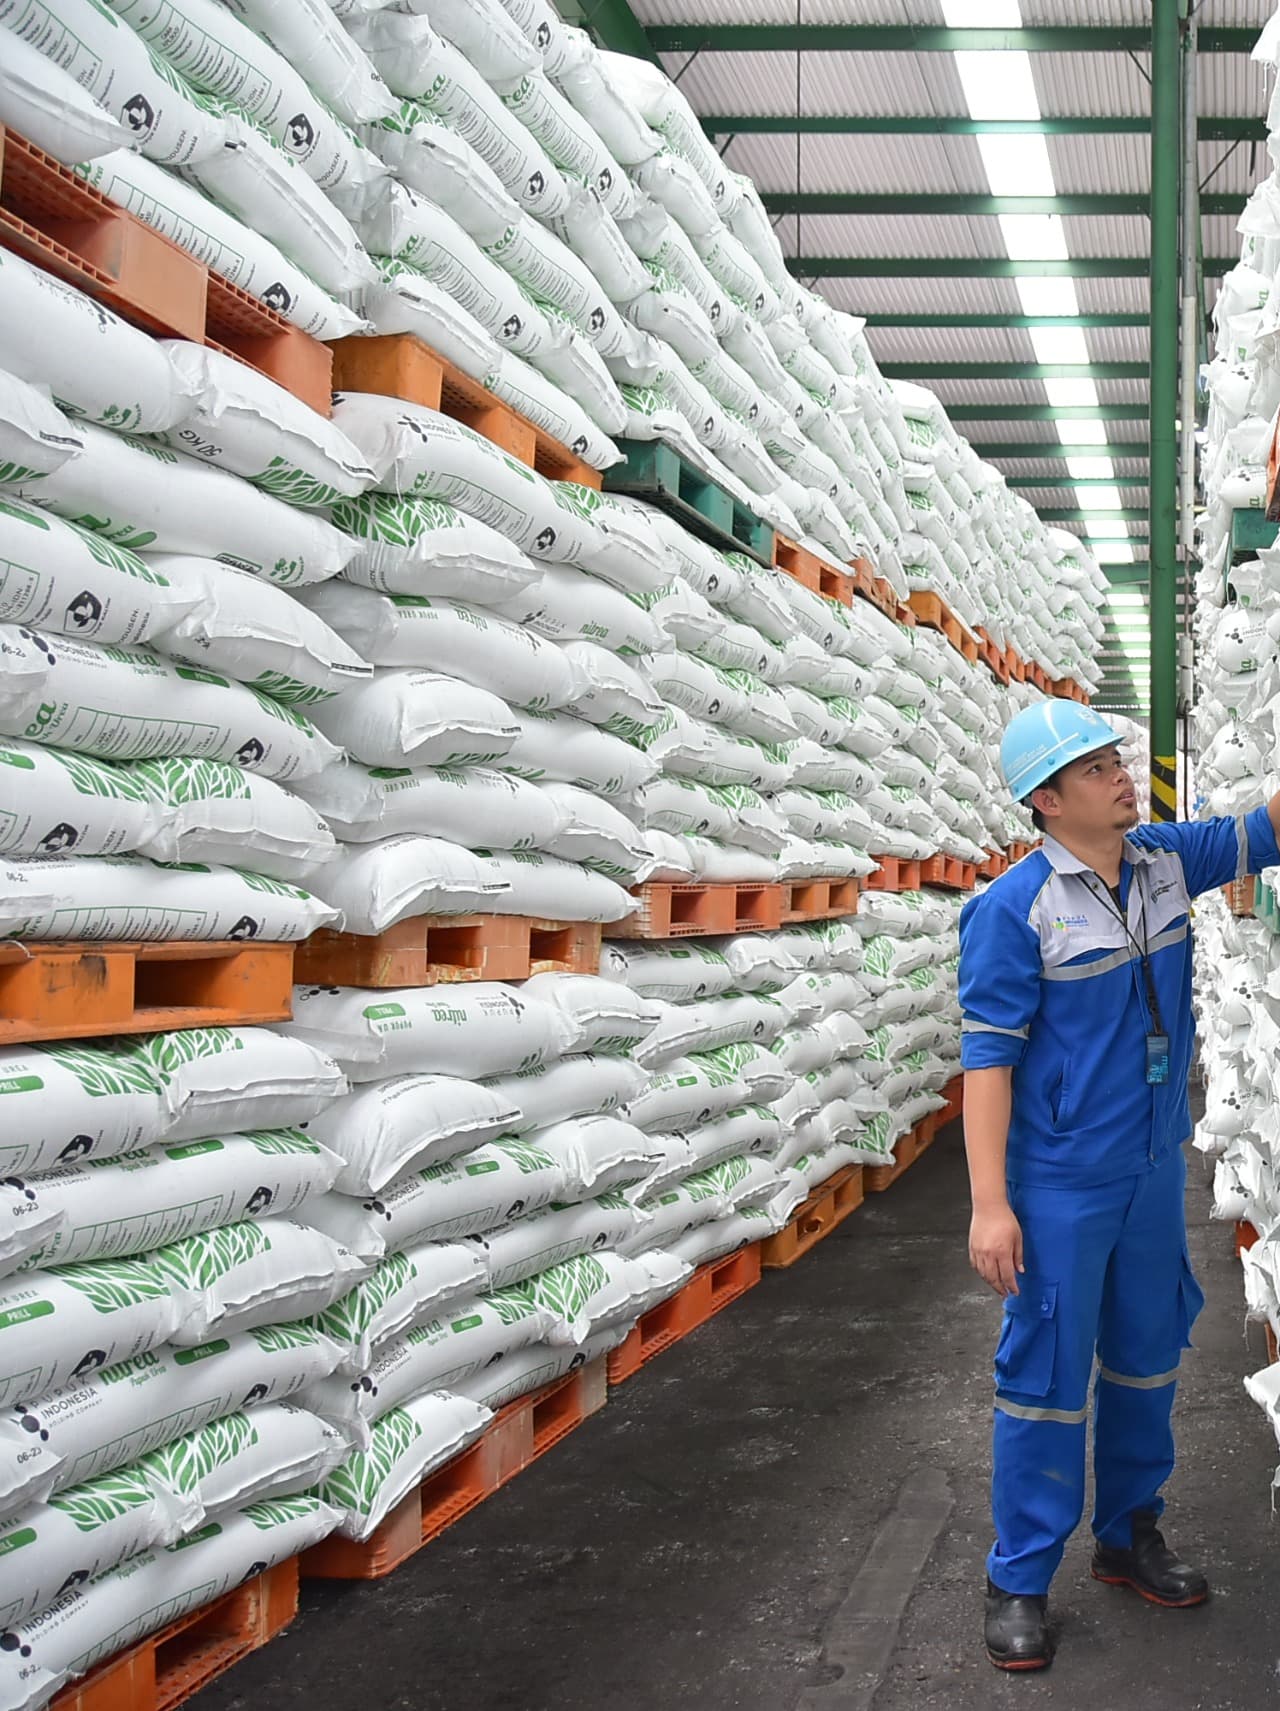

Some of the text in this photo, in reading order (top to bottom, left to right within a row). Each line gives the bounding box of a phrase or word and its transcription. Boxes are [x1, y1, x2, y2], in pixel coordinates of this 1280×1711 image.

[179, 429, 223, 457] 50 KG
[432, 1008, 468, 1026] nitrea
[7, 1308, 31, 1322] PRILL
[407, 1319, 442, 1346] nitrea
[371, 1346, 410, 1377] INDONESIA
[41, 1387, 98, 1419] INDONESIA
[22, 1590, 83, 1634] INDONESIA
